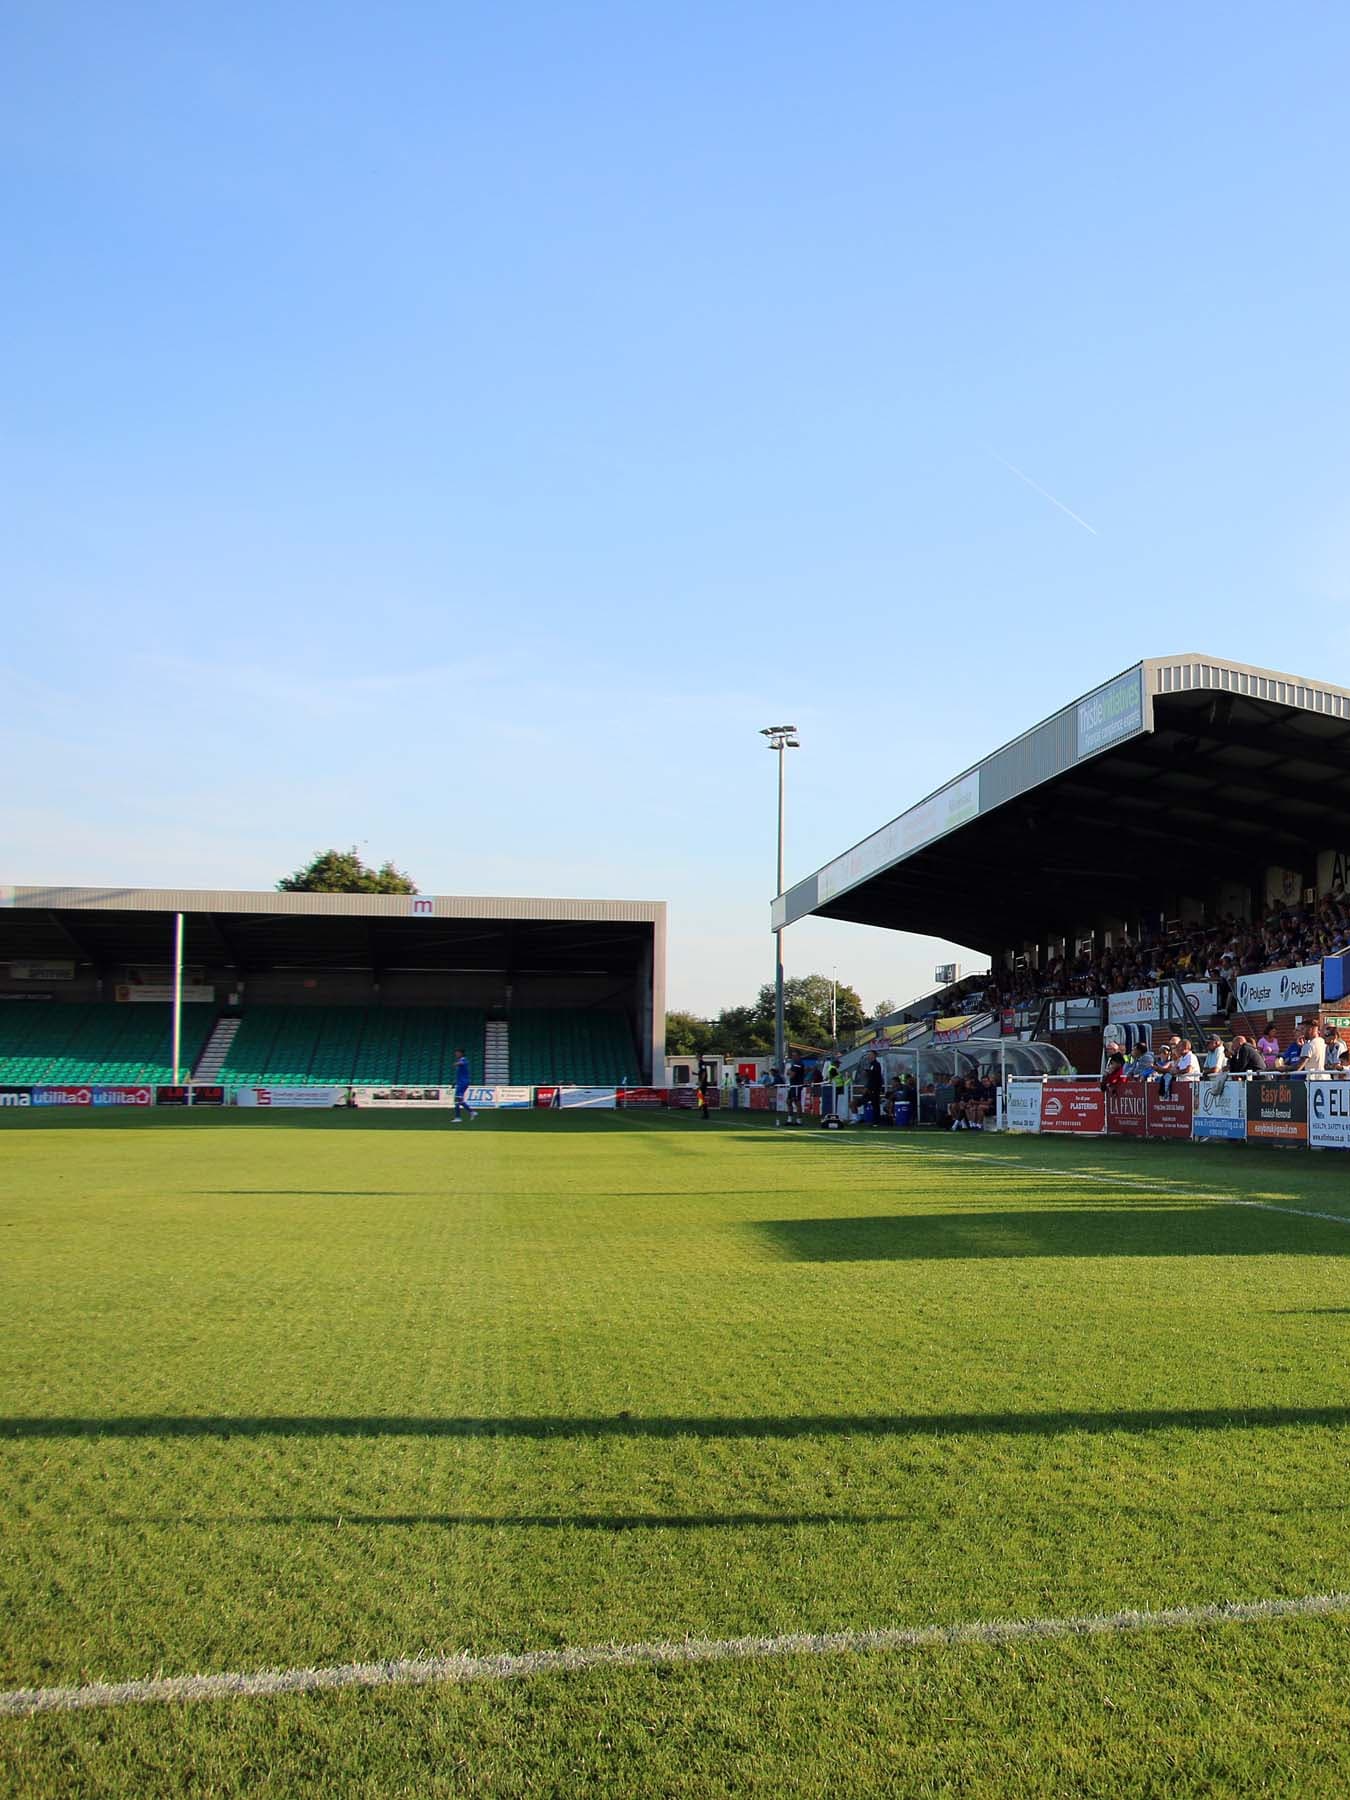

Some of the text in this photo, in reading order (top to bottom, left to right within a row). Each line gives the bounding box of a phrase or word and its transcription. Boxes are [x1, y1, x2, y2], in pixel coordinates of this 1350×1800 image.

[414, 900, 433, 913] m
[1249, 985, 1272, 1003] Polystar
[1291, 979, 1315, 998] Polystar
[33, 1090, 77, 1104] utilita
[93, 1090, 133, 1104] utilita
[467, 1089, 495, 1101] LTS
[1261, 1084, 1292, 1107] Easy Bin
